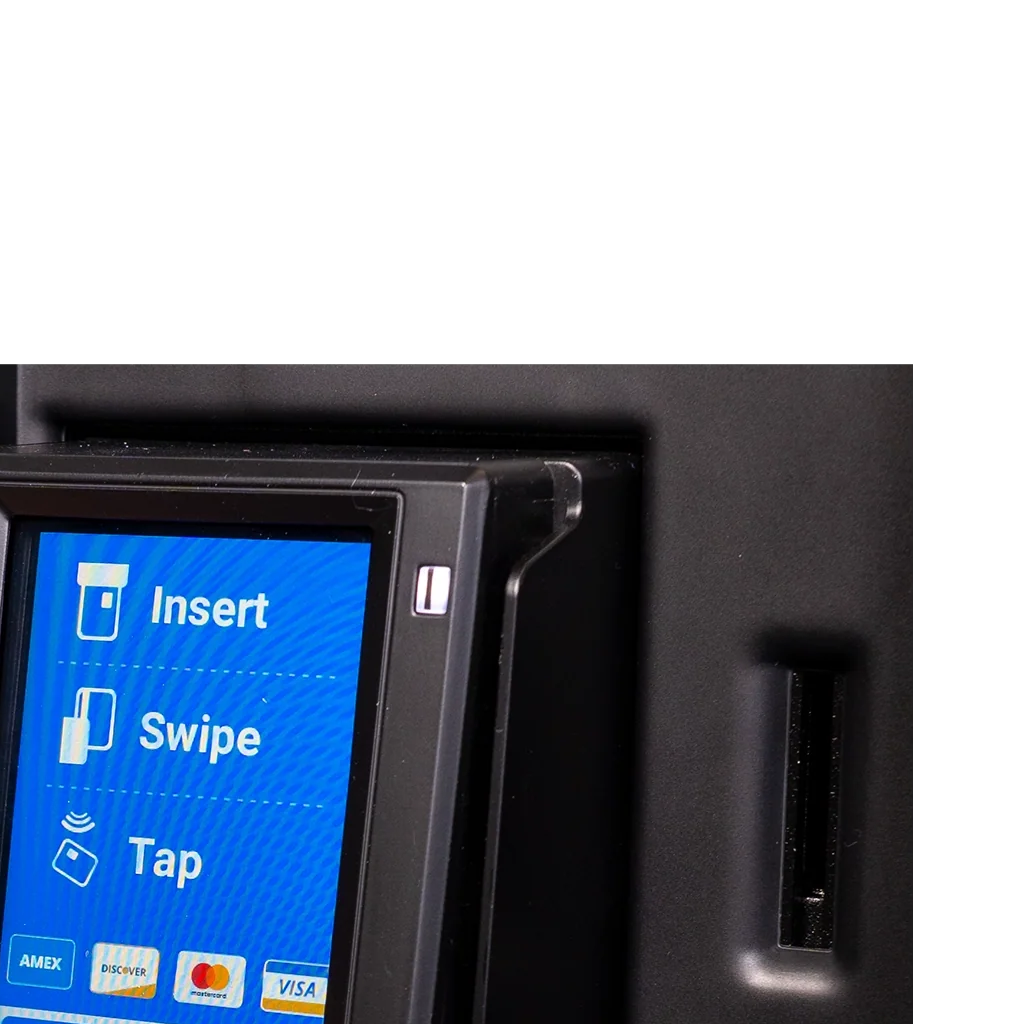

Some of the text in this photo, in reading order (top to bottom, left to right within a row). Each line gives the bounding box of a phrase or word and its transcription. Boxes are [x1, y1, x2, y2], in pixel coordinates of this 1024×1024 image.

[151, 586, 269, 629] Insert
[139, 711, 261, 764] Swipe
[128, 836, 203, 889] Tap
[19, 953, 63, 971] AMEX
[101, 963, 147, 977] DISCOVER
[191, 990, 227, 999] mastercard
[278, 979, 317, 998] VISA
